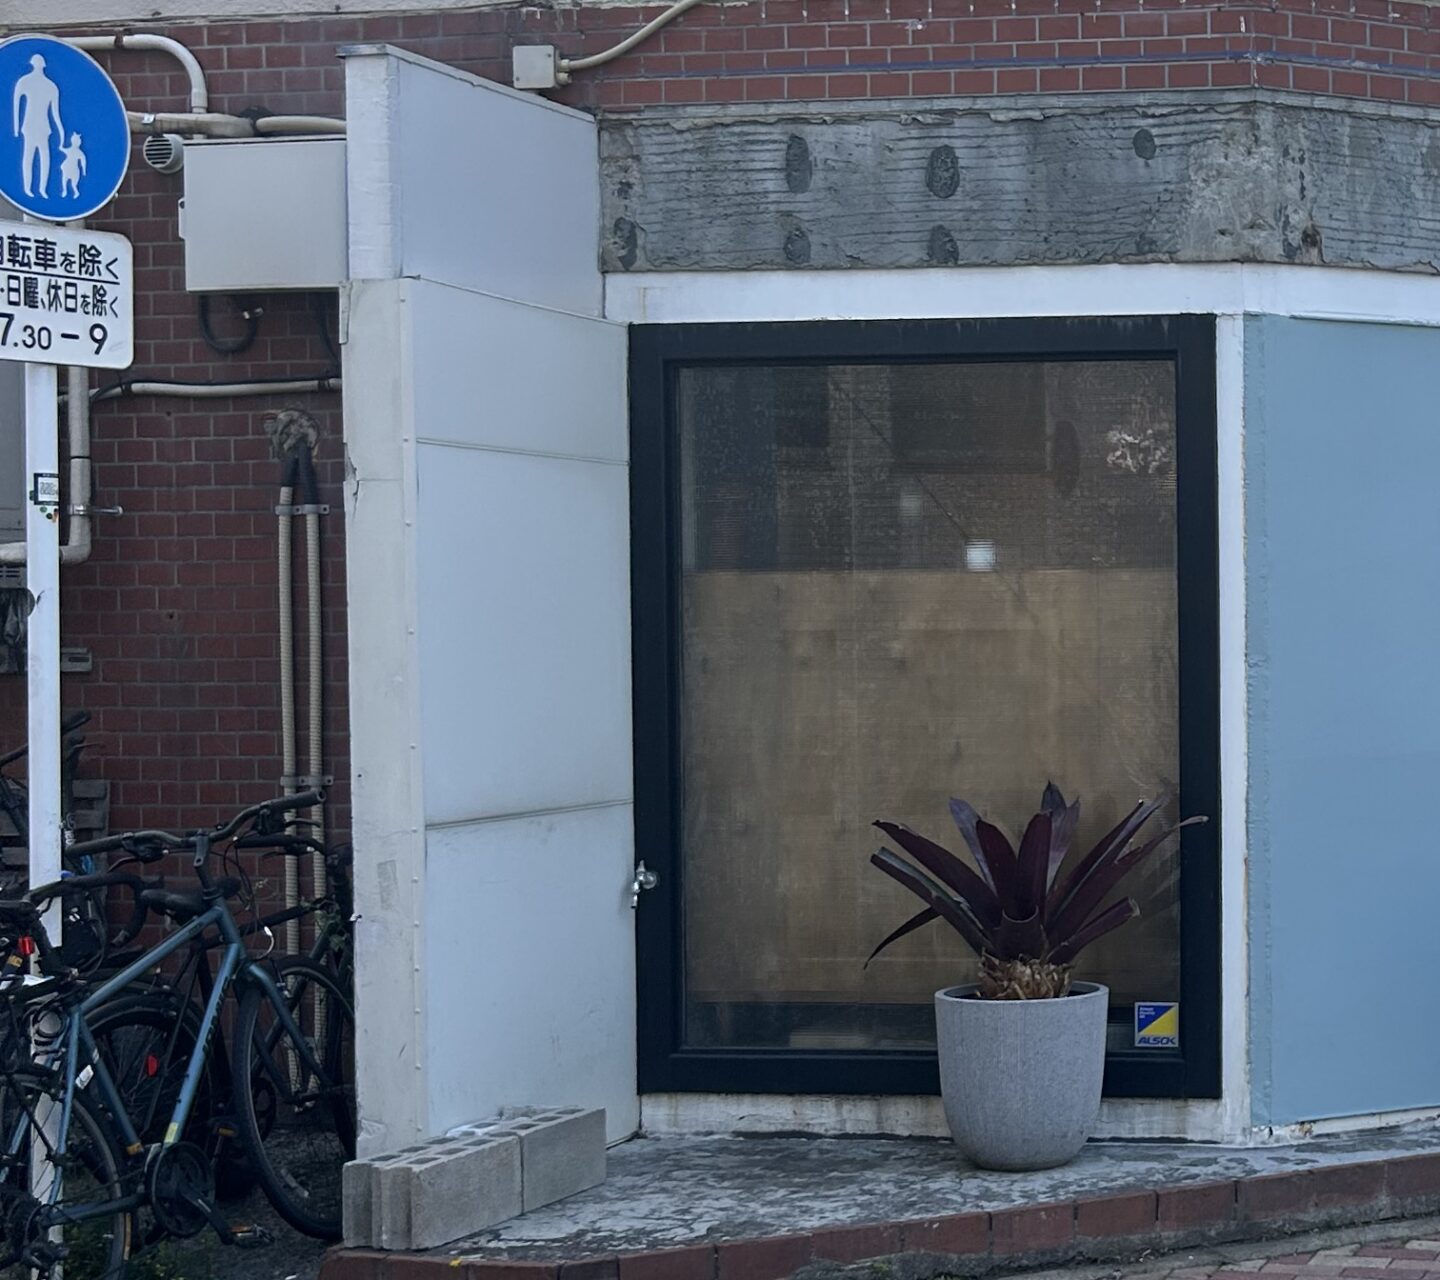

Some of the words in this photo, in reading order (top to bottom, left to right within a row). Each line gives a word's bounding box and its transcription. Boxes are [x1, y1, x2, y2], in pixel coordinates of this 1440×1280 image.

[0, 233, 119, 280] 転車を除く
[1137, 1036, 1177, 1045] ALSOK
